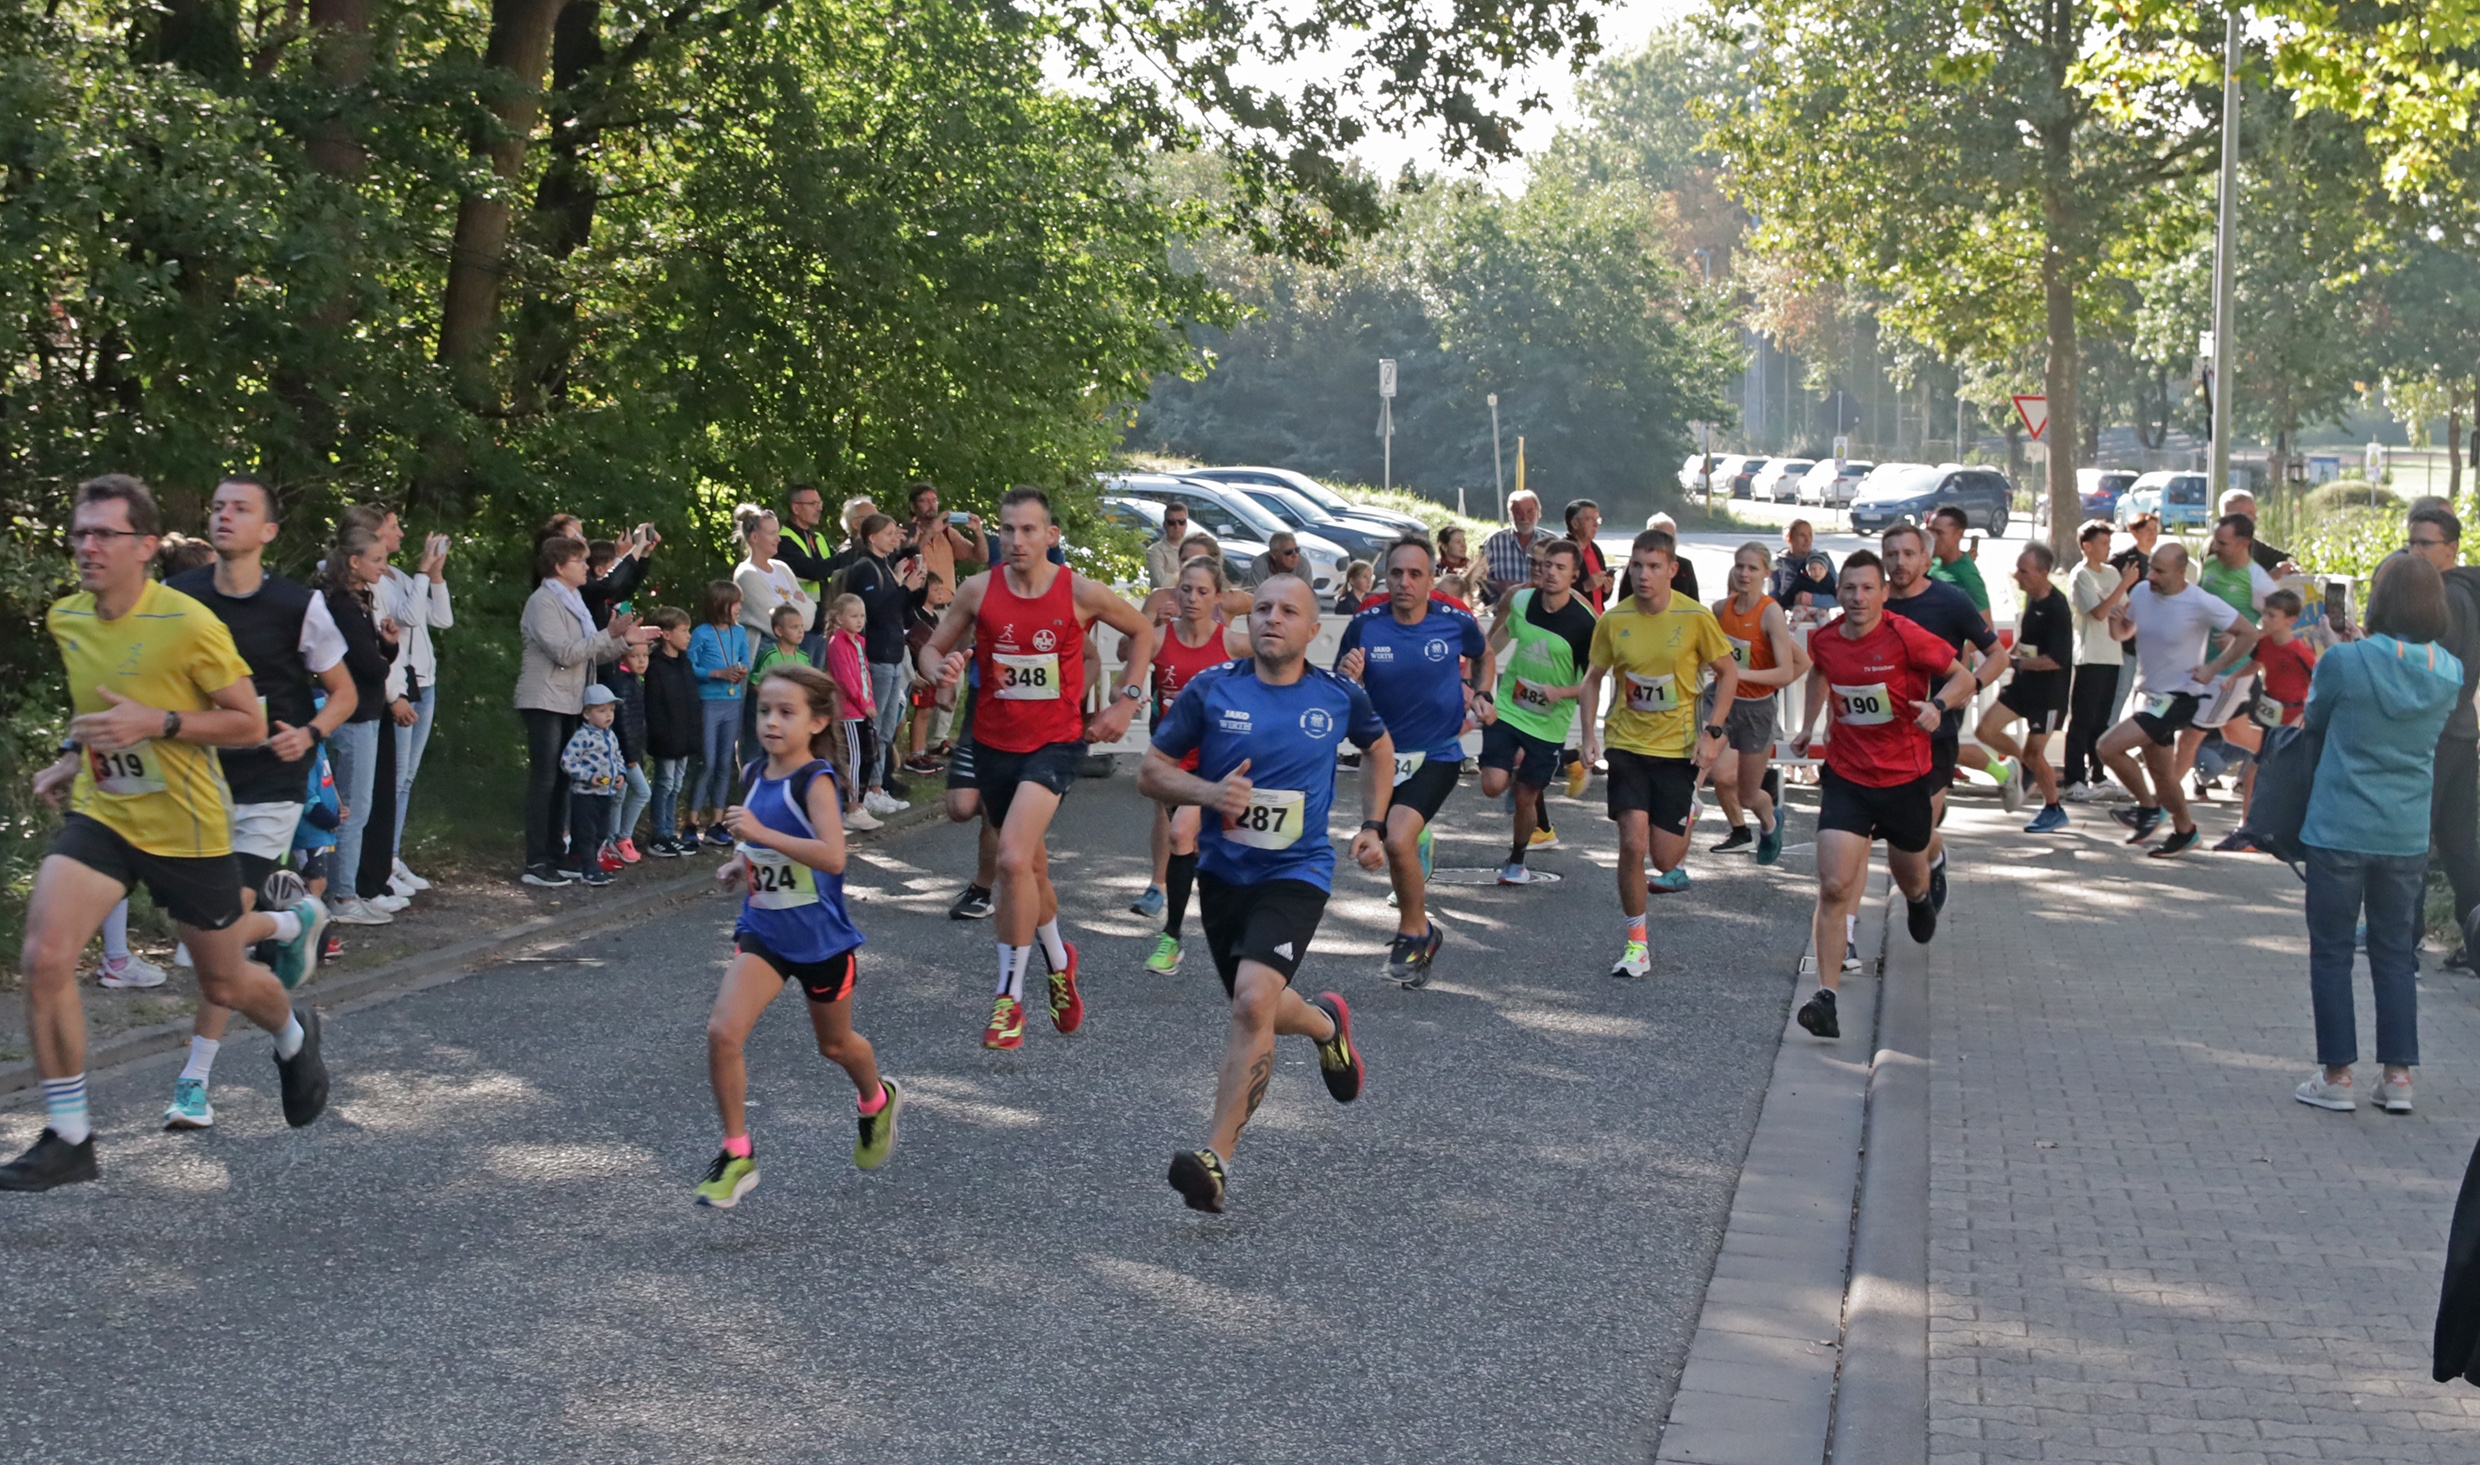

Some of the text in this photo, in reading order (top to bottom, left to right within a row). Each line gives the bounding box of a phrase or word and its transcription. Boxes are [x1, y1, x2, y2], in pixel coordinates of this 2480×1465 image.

[1004, 667, 1047, 687] 348
[1520, 688, 1545, 706] 482
[1633, 686, 1664, 701] 471
[1842, 697, 1879, 714] 190
[1224, 710, 1250, 720] JAKO
[1219, 720, 1252, 731] WIRTH
[97, 752, 144, 777] 319
[1236, 805, 1288, 833] 287
[751, 865, 797, 892] 324
